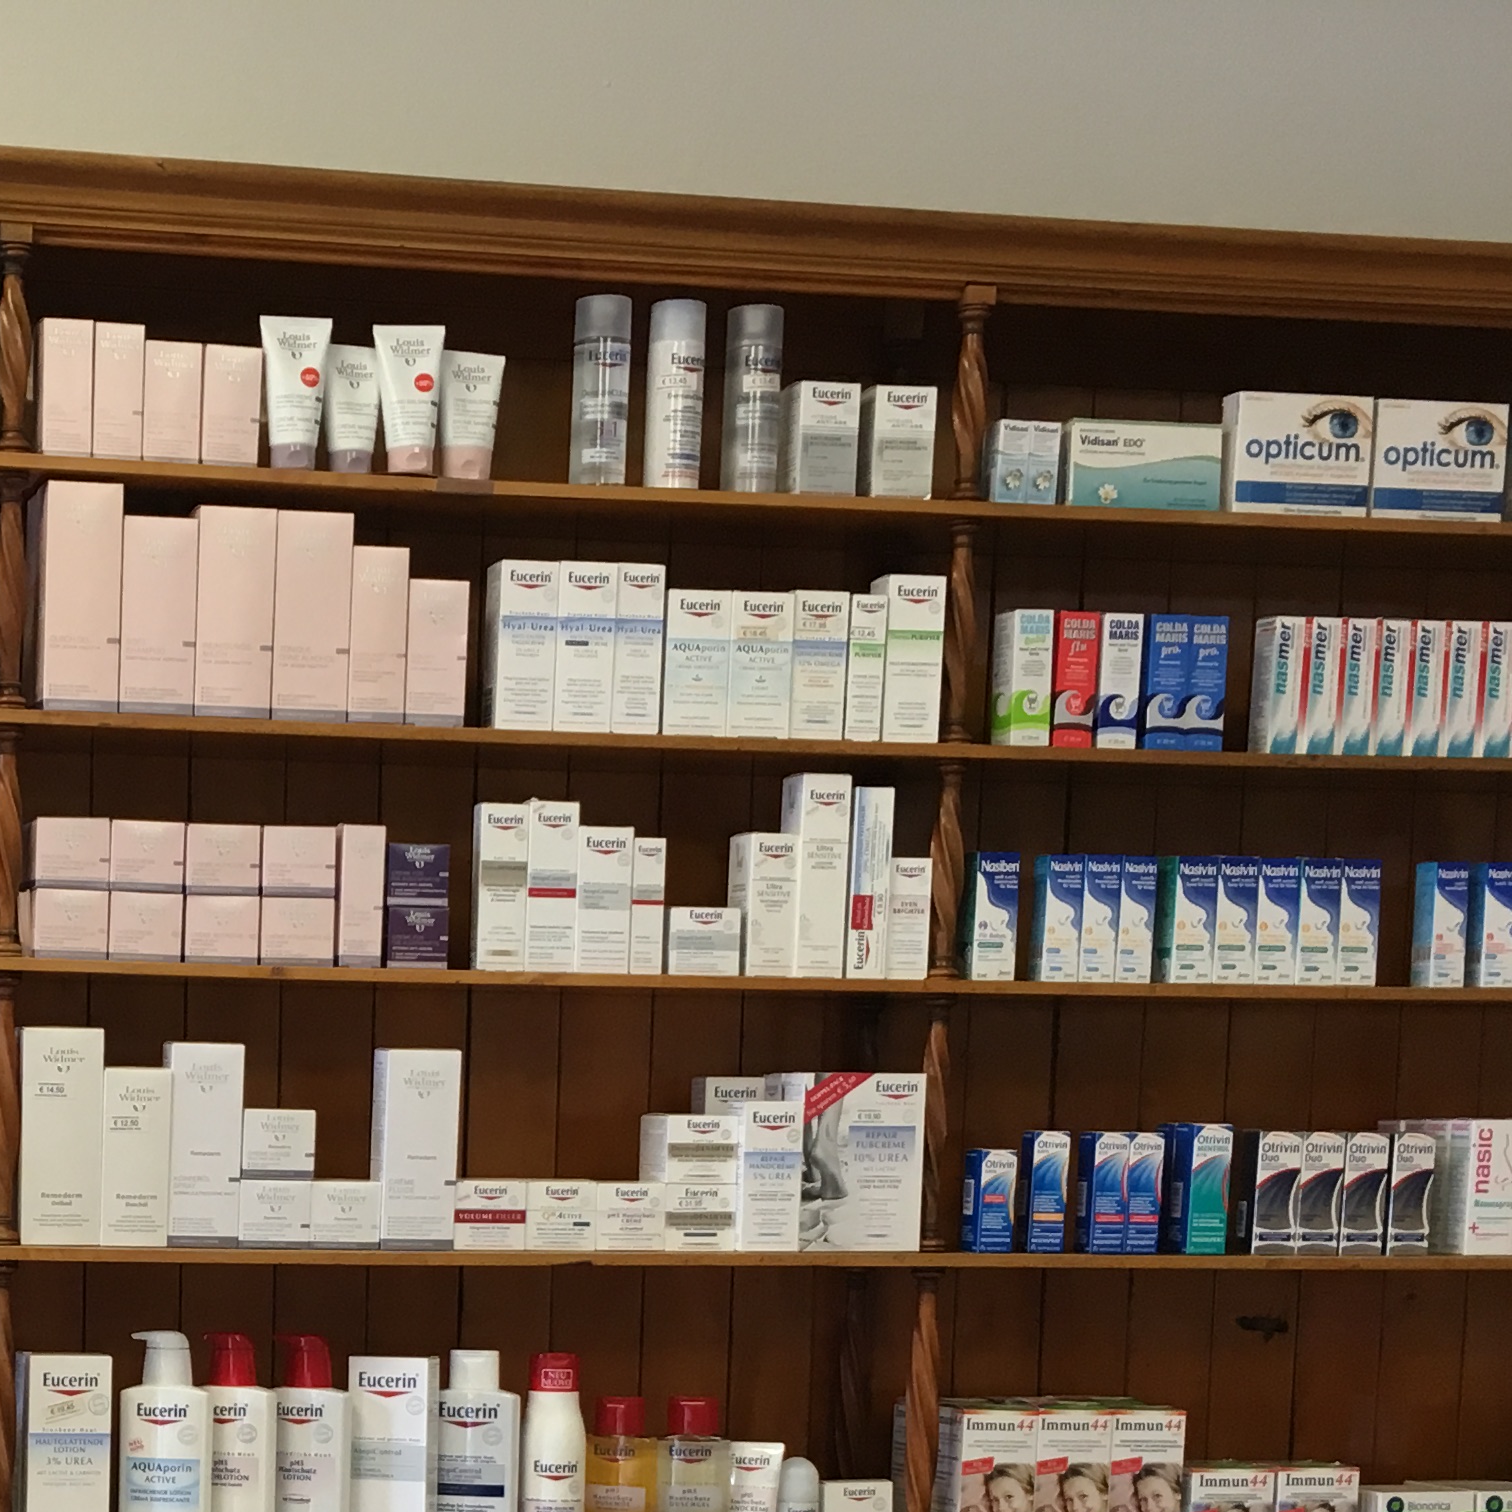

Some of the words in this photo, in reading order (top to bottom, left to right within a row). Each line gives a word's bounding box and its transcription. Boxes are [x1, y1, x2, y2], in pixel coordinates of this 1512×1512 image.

[283, 332, 310, 341] Louis
[277, 338, 317, 349] Widmer
[396, 338, 425, 347] Louis
[390, 346, 431, 355] Widmer
[340, 360, 367, 370] Louis
[457, 364, 485, 373] Louis
[336, 367, 373, 378] Widmer
[452, 371, 491, 382] Widmer
[812, 387, 852, 400] Eucerin
[888, 391, 928, 403] Eucerin
[1080, 435, 1120, 446] Vidisan
[1124, 439, 1143, 447] EDO
[1246, 433, 1360, 464] opticum
[1384, 442, 1495, 471] opticum
[511, 570, 551, 583] Eucerin
[568, 572, 609, 584] Eucerin
[624, 572, 659, 583] Eucerin
[898, 586, 938, 596] Eucerin
[680, 599, 720, 610] Eucerin
[744, 601, 784, 612] Eucerin
[802, 601, 841, 612] Eucerin
[1064, 618, 1095, 628] COLDA
[1109, 620, 1139, 630] COLDA
[1156, 622, 1188, 631] COLDA
[1194, 624, 1226, 634] COLDA
[1109, 630, 1139, 640] MARIS
[1276, 621, 1291, 694] nasmer
[1313, 622, 1327, 695] nasmer
[1348, 624, 1362, 695] nasmer
[1381, 625, 1396, 697] nasmer
[1417, 626, 1432, 697] nasmer
[1452, 626, 1468, 699] nasmer
[1489, 627, 1504, 699] nasmer
[488, 814, 523, 824] Eucerin
[538, 813, 571, 823] Eucerin
[587, 837, 626, 848] Eucerin
[1051, 861, 1082, 872] Nasivin
[1088, 862, 1120, 872] Nasivin
[1125, 863, 1157, 873] Nasivin
[1179, 863, 1216, 876] Nasivin
[1221, 864, 1257, 876] Nasivin
[1262, 865, 1298, 877] Nasivin
[1305, 866, 1340, 878] Nasivin
[1344, 867, 1380, 878] Nasivin
[1438, 868, 1468, 879] Nasivin
[49, 1047, 78, 1055] Louis
[42, 1054, 85, 1063] Widmer
[876, 1081, 918, 1092] Eucerin
[753, 1112, 795, 1123] Eucerin
[1038, 1140, 1067, 1149] Otrivin
[1197, 1135, 1230, 1144] Otrivin
[1099, 1142, 1127, 1150] Otrivin
[1262, 1142, 1299, 1153] Otrivin
[1305, 1142, 1342, 1153] Otrivin
[1350, 1143, 1386, 1153] Otrivin
[1397, 1143, 1433, 1153] Otrivin
[854, 1154, 875, 1162] 10%
[878, 1154, 908, 1162] UREA
[1262, 1154, 1279, 1162] Duo
[1305, 1154, 1322, 1162] Duo
[1349, 1154, 1366, 1162] Duo
[1473, 1128, 1493, 1193] nasic
[985, 1160, 1015, 1168] Otrivin
[43, 1373, 98, 1386] Eucerin
[359, 1372, 416, 1388] Eucerin
[137, 1403, 187, 1417] Eucerin
[967, 1418, 1034, 1431] Immun44
[1041, 1418, 1109, 1431] Immun44
[1115, 1418, 1182, 1431] Immun44
[131, 1462, 192, 1473] AQUAporin
[534, 1460, 577, 1473] Eucerin
[145, 1476, 176, 1484] ACTIVE
[1199, 1474, 1268, 1488] Immun44
[1286, 1473, 1352, 1487] Immun44
